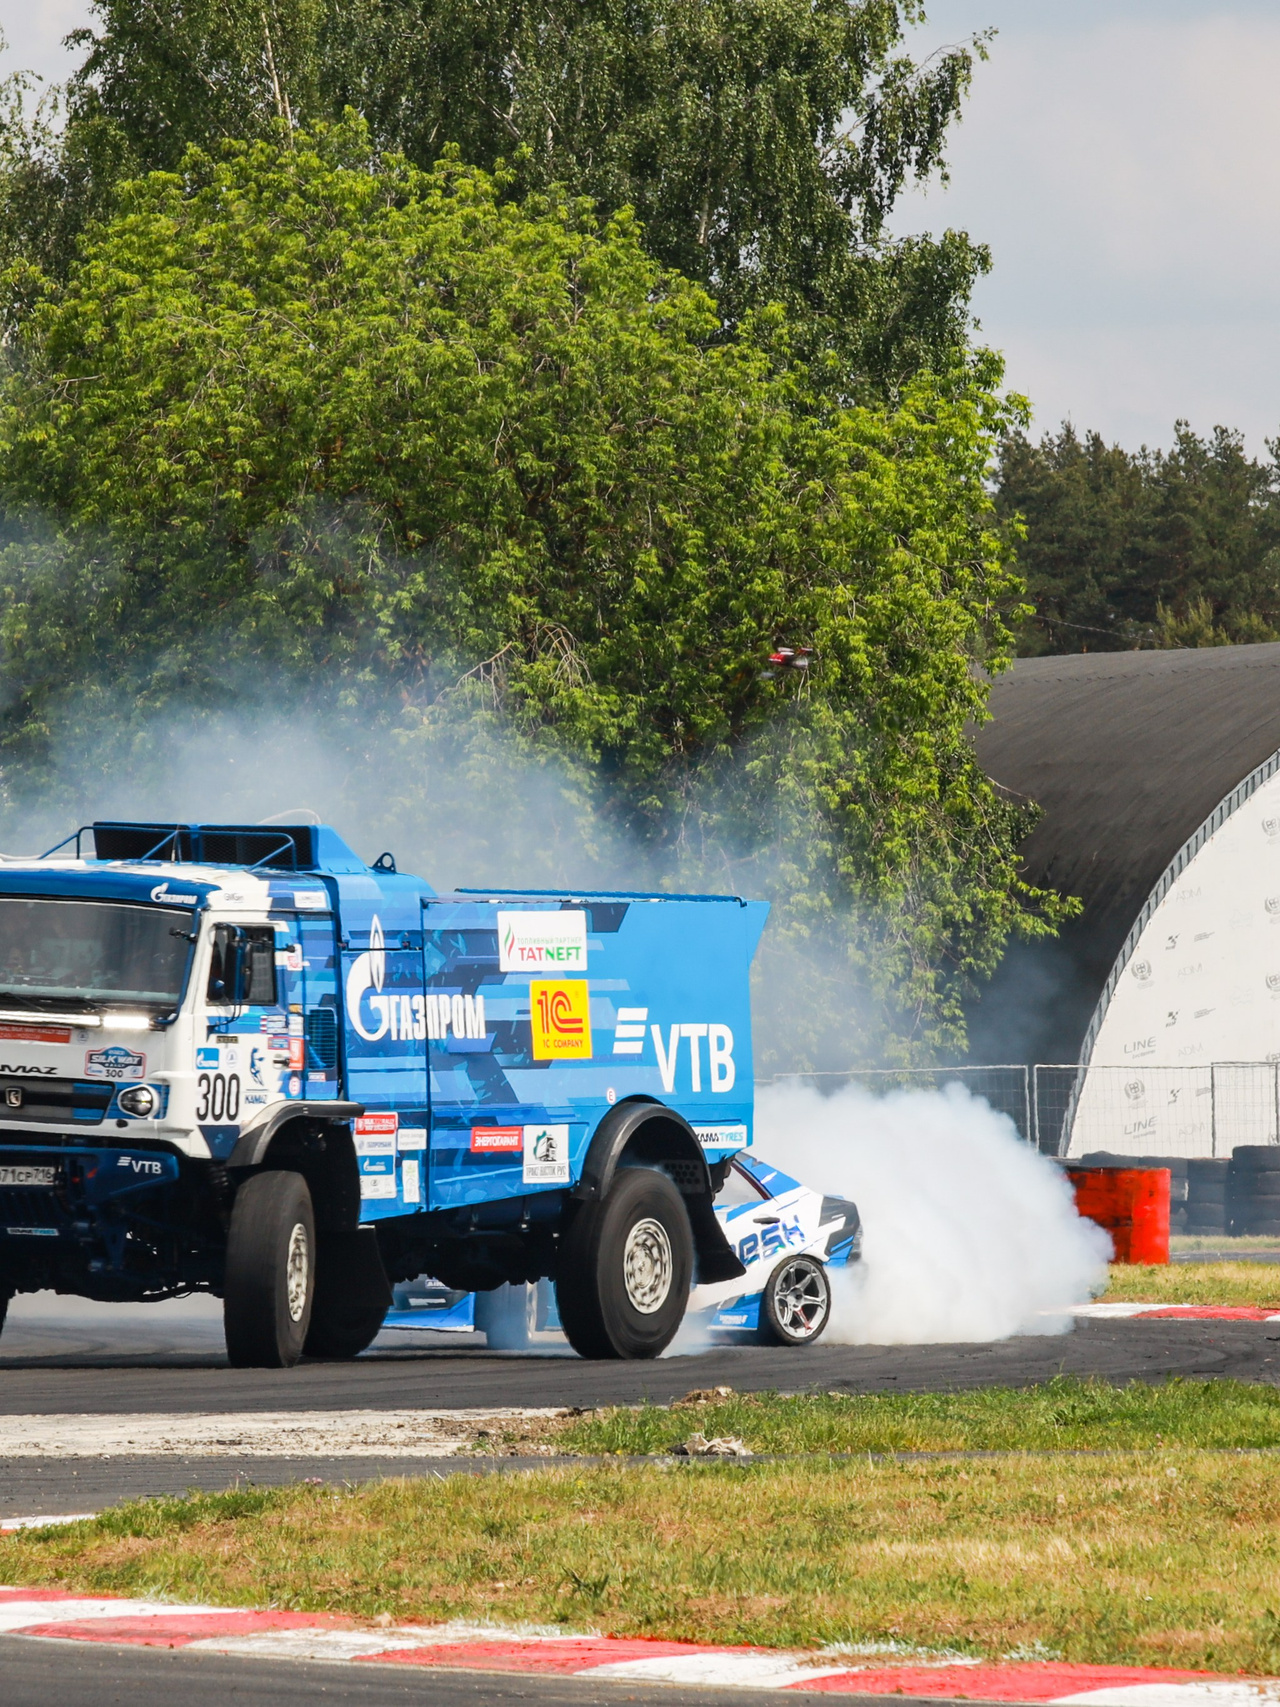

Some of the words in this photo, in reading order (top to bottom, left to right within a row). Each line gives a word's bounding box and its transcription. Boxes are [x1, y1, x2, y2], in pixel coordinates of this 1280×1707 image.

[518, 946, 582, 961] TATNEFT
[543, 1039, 550, 1048] 1C
[554, 1039, 583, 1048] COMPANY
[1124, 1036, 1157, 1054] LINE
[90, 1055, 117, 1064] SILK
[118, 1056, 141, 1065] WAY
[650, 1023, 736, 1093] VTB
[105, 1069, 124, 1078] 300
[196, 1073, 240, 1122] 300
[1124, 1116, 1158, 1135] LINE
[719, 1132, 744, 1142] TYRES
[131, 1160, 162, 1174] VTB
